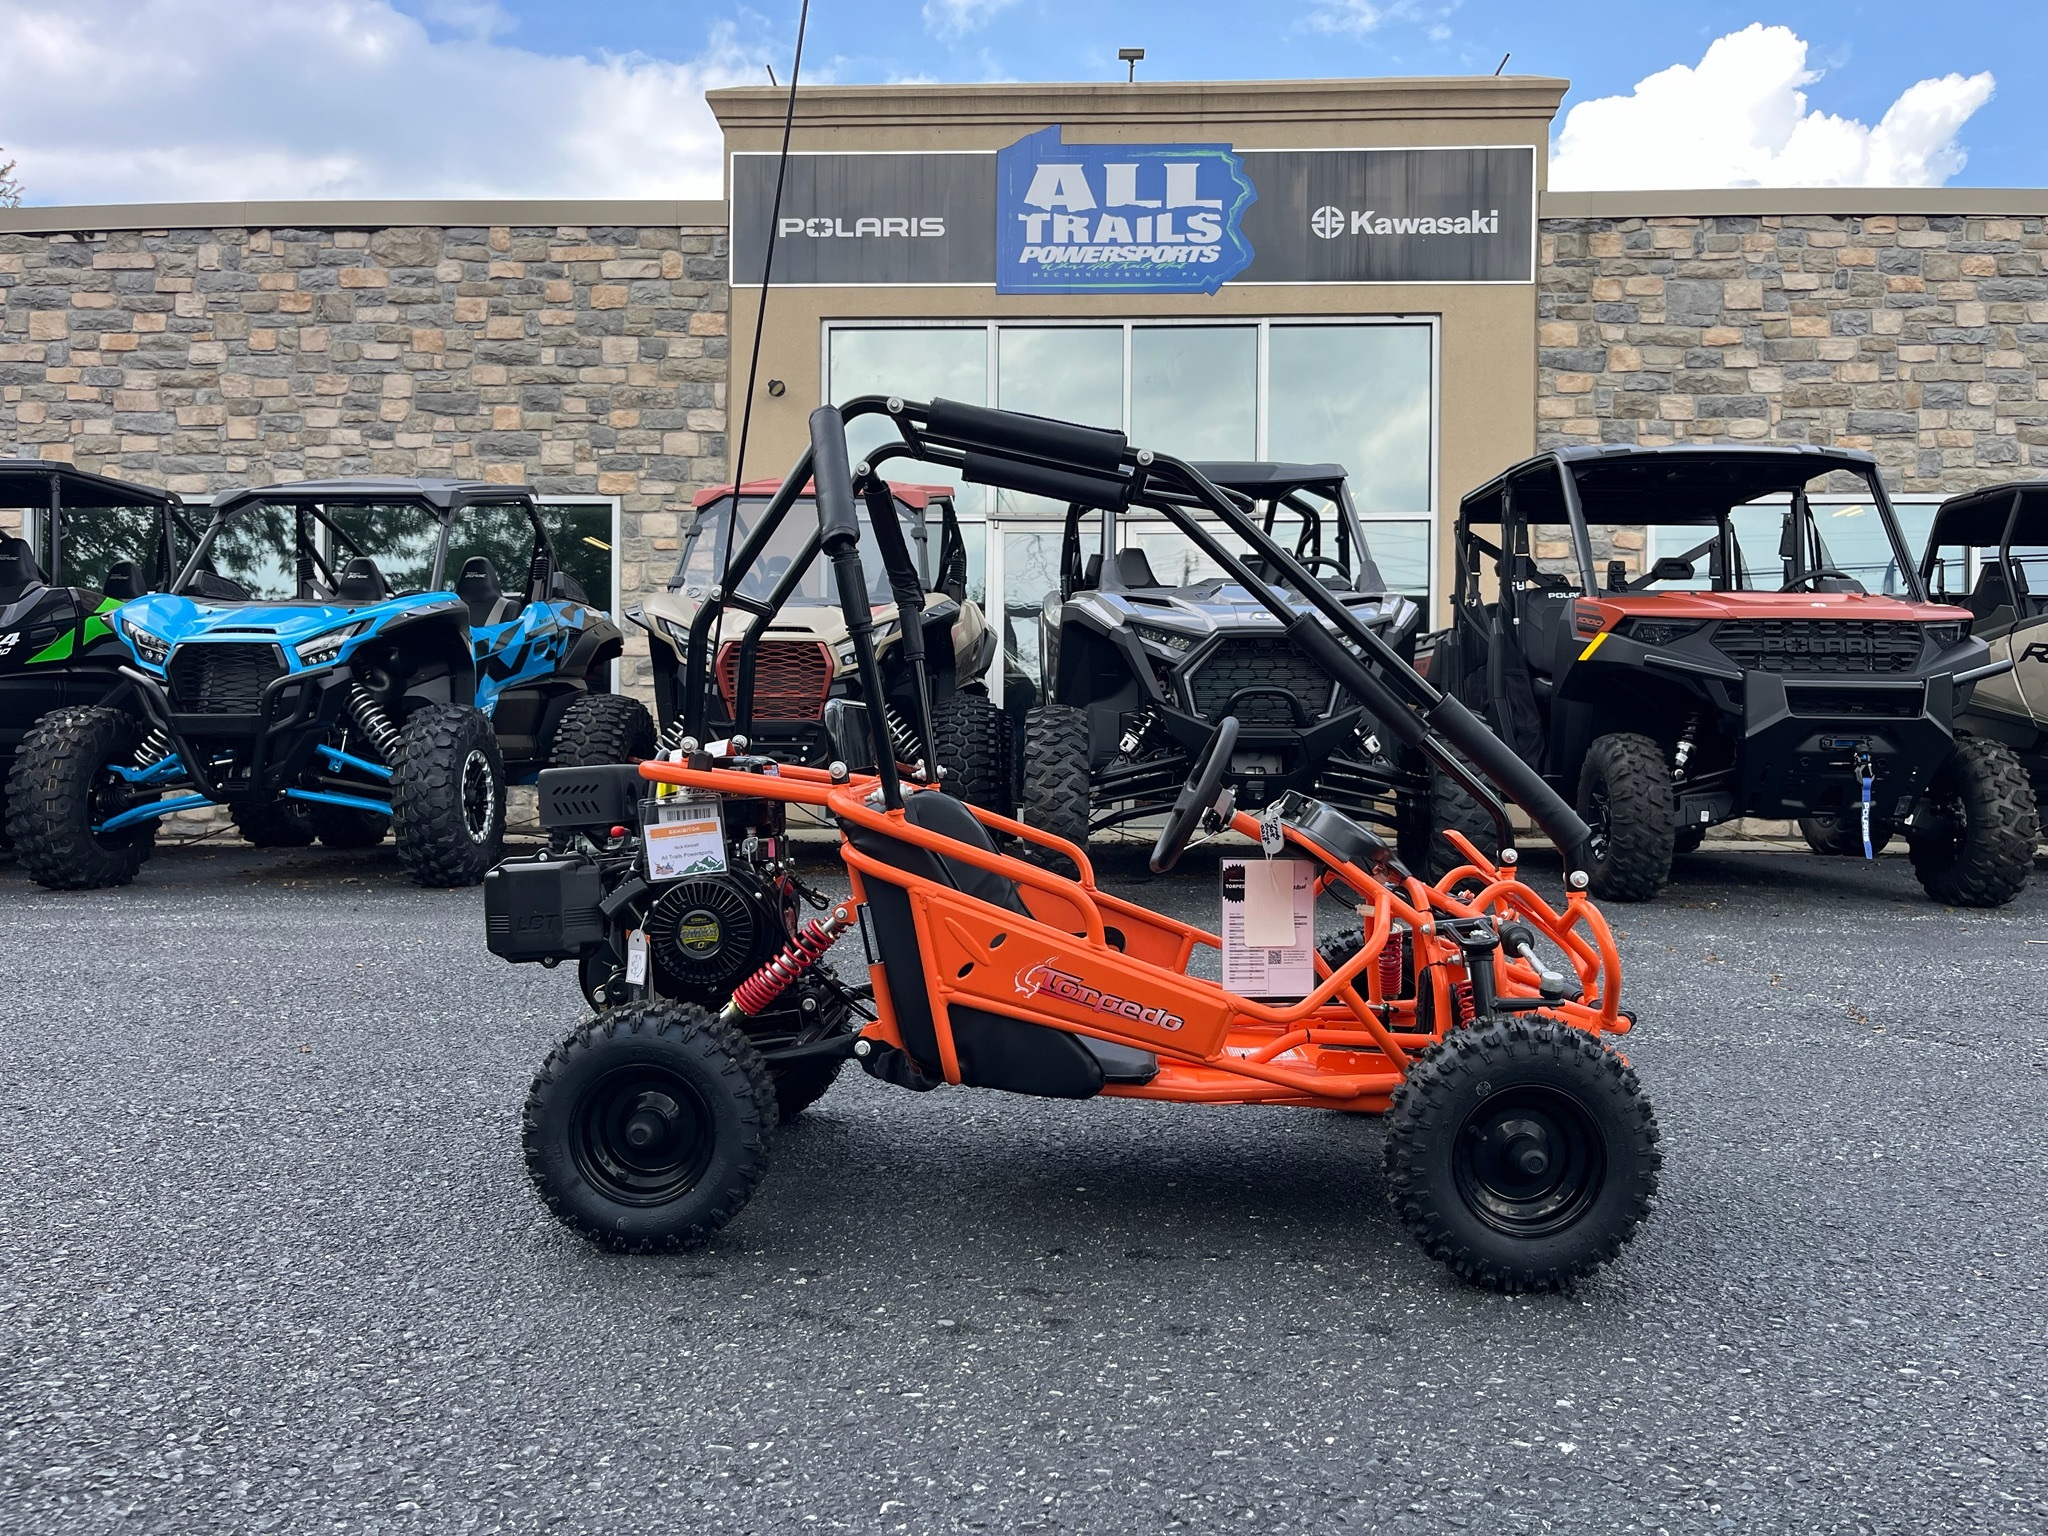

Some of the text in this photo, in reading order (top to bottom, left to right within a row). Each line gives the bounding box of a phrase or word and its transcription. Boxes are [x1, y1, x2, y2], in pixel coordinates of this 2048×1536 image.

[1024, 163, 1222, 212] ALL
[779, 217, 945, 238] POLARIS
[1018, 211, 1222, 243] TRAILS
[1351, 209, 1499, 235] Kawasaki
[1018, 245, 1221, 264] POWERSPORTS
[1576, 616, 1605, 627] 1000
[1763, 637, 1892, 653] POLARIS
[668, 826, 700, 835] EXHIBITOR
[683, 850, 714, 859] Powersports
[1035, 966, 1185, 1032] Torpedo
